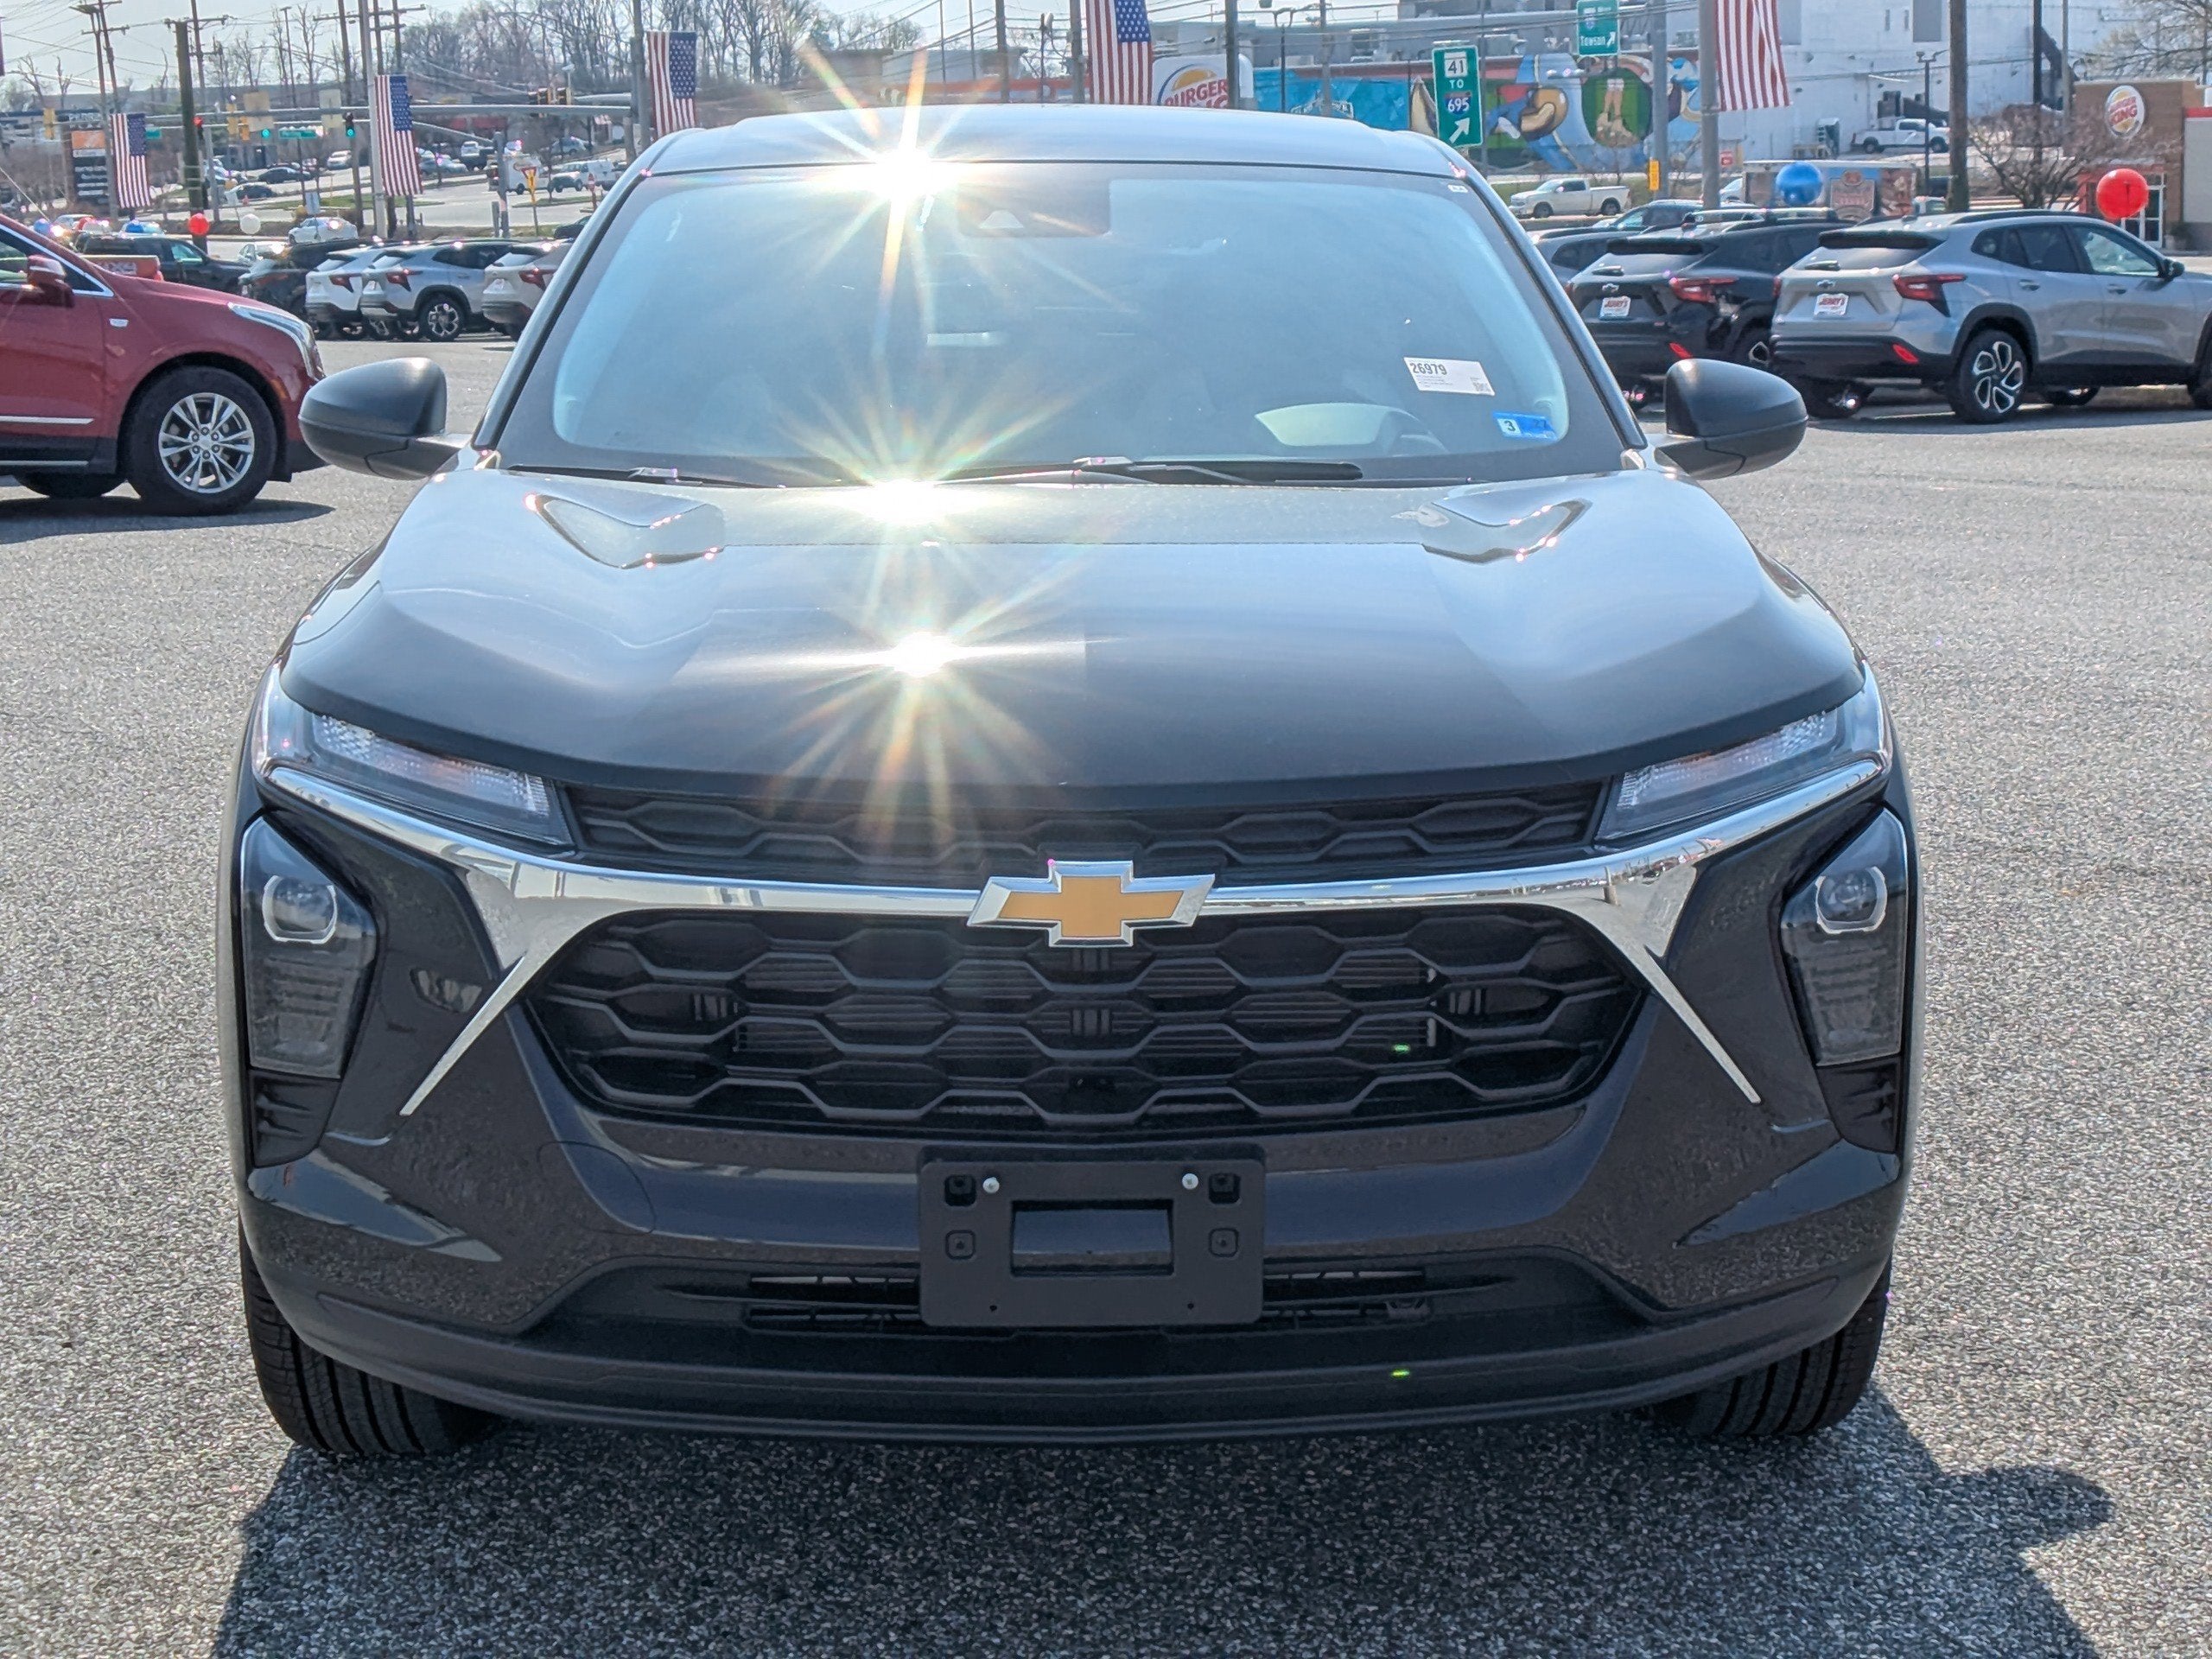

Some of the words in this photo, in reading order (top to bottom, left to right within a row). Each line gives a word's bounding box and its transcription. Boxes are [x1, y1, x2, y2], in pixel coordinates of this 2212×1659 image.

[1580, 35, 1606, 47] Towson
[1447, 60, 1465, 74] 41
[1449, 79, 1465, 89] TO
[1447, 97, 1470, 113] 695
[2108, 104, 2138, 126] KING
[1409, 362, 1447, 376] 26979
[1503, 420, 1516, 432] 3
